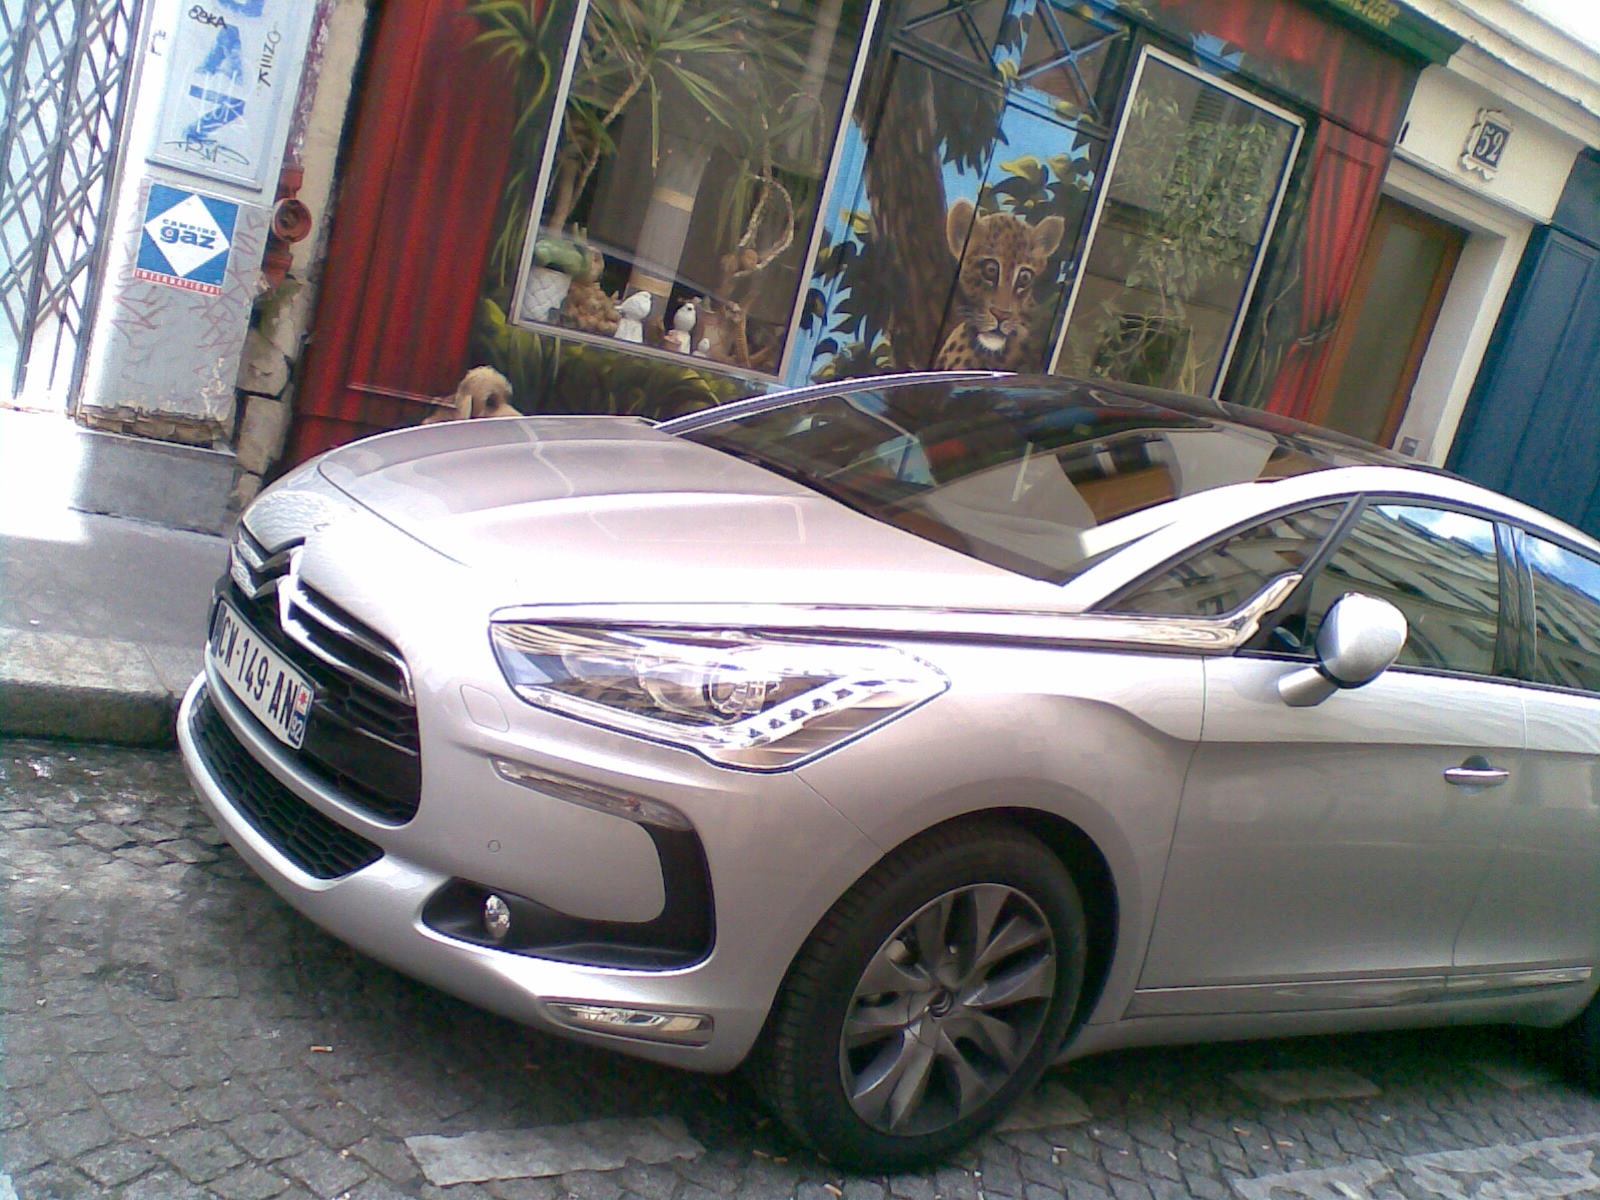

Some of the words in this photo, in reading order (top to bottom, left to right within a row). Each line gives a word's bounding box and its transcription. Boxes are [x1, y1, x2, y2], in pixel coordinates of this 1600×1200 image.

[1476, 125, 1504, 161] 52
[160, 226, 216, 250] gaz
[162, 218, 217, 236] CAMPING
